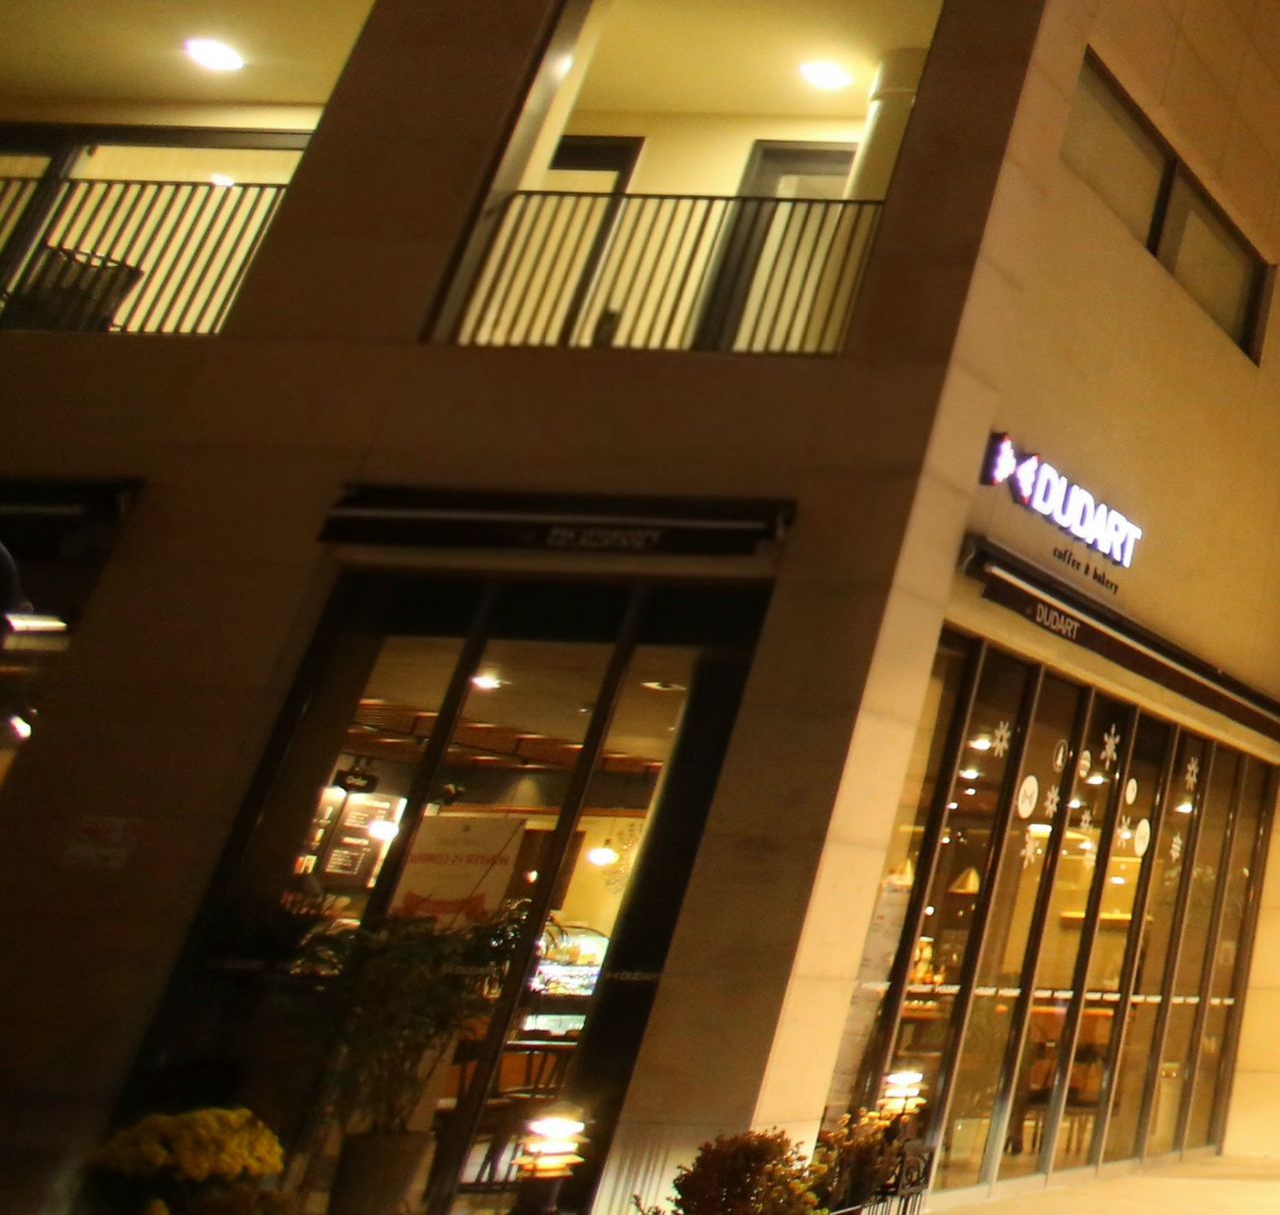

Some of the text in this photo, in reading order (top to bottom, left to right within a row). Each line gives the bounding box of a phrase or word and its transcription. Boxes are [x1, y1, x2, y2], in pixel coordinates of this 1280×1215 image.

[1031, 462, 1143, 569] DUDART
[1052, 547, 1081, 571] coffee
[1092, 566, 1119, 595] bakery
[1035, 602, 1081, 641] DUDART
